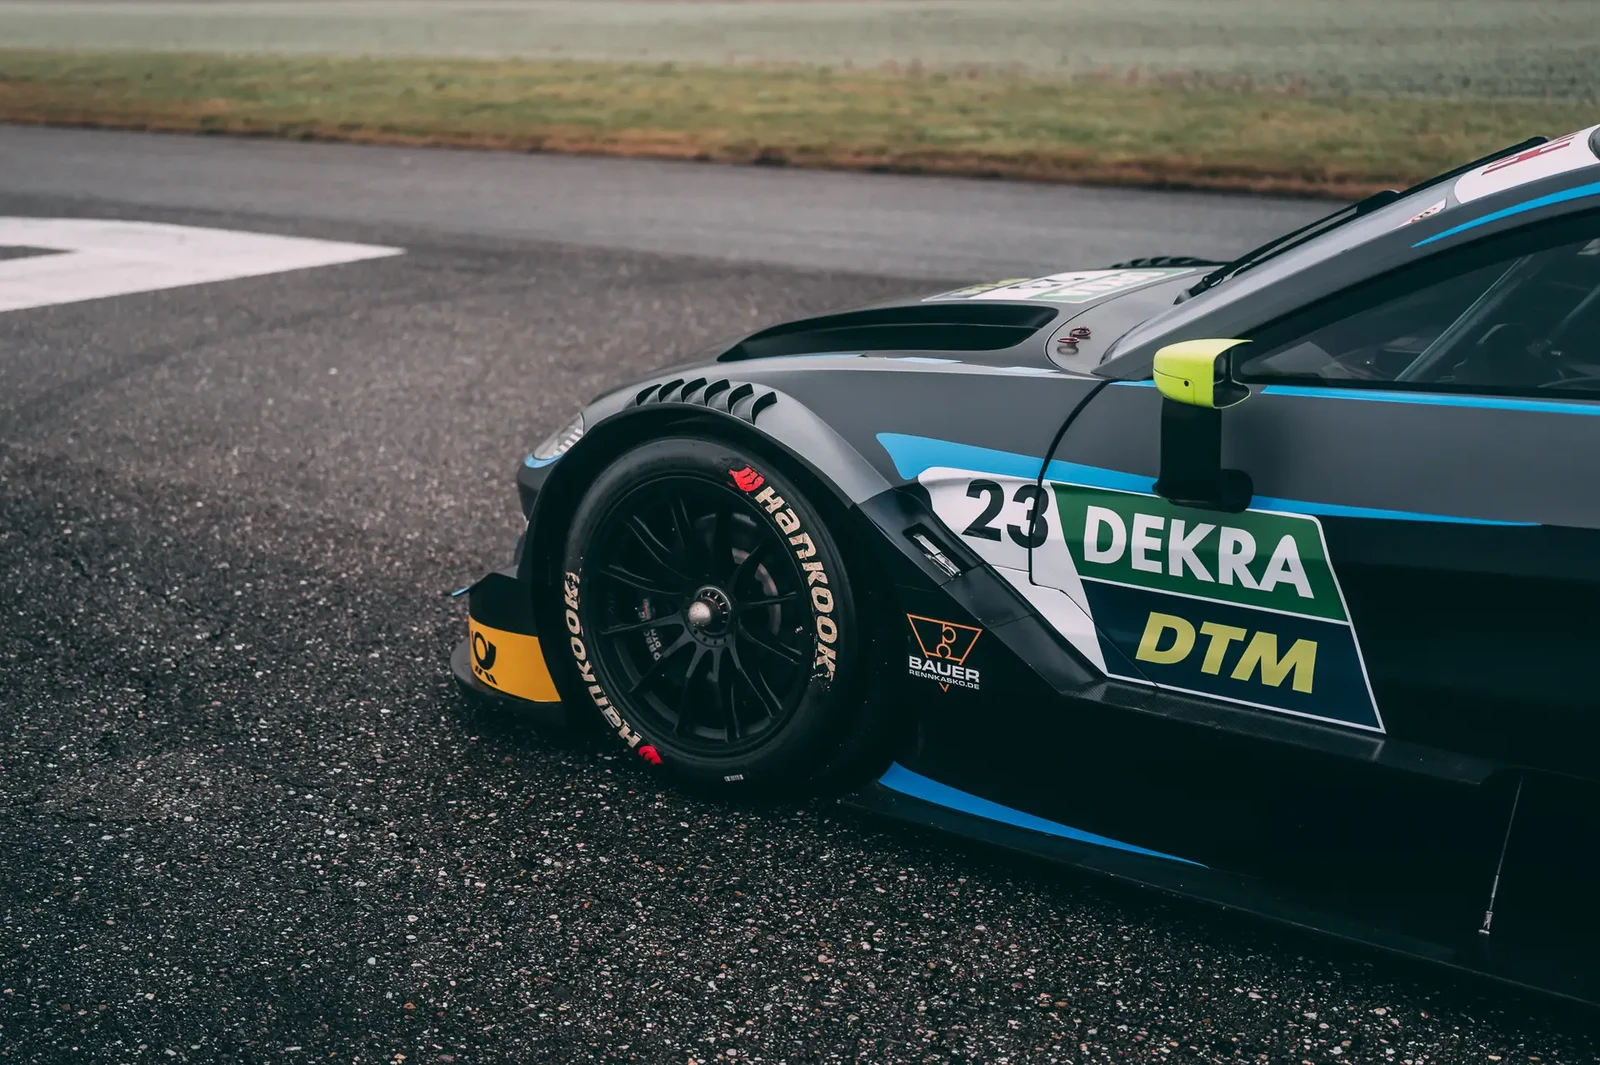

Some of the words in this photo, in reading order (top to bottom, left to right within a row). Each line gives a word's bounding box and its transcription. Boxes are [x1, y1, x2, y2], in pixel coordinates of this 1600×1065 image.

[961, 478, 1049, 549] 23
[1083, 505, 1315, 599] DEKRA
[909, 655, 980, 683] BAUER
[909, 668, 980, 691] RENNKASKO.DE
[1135, 611, 1318, 694] DTM
